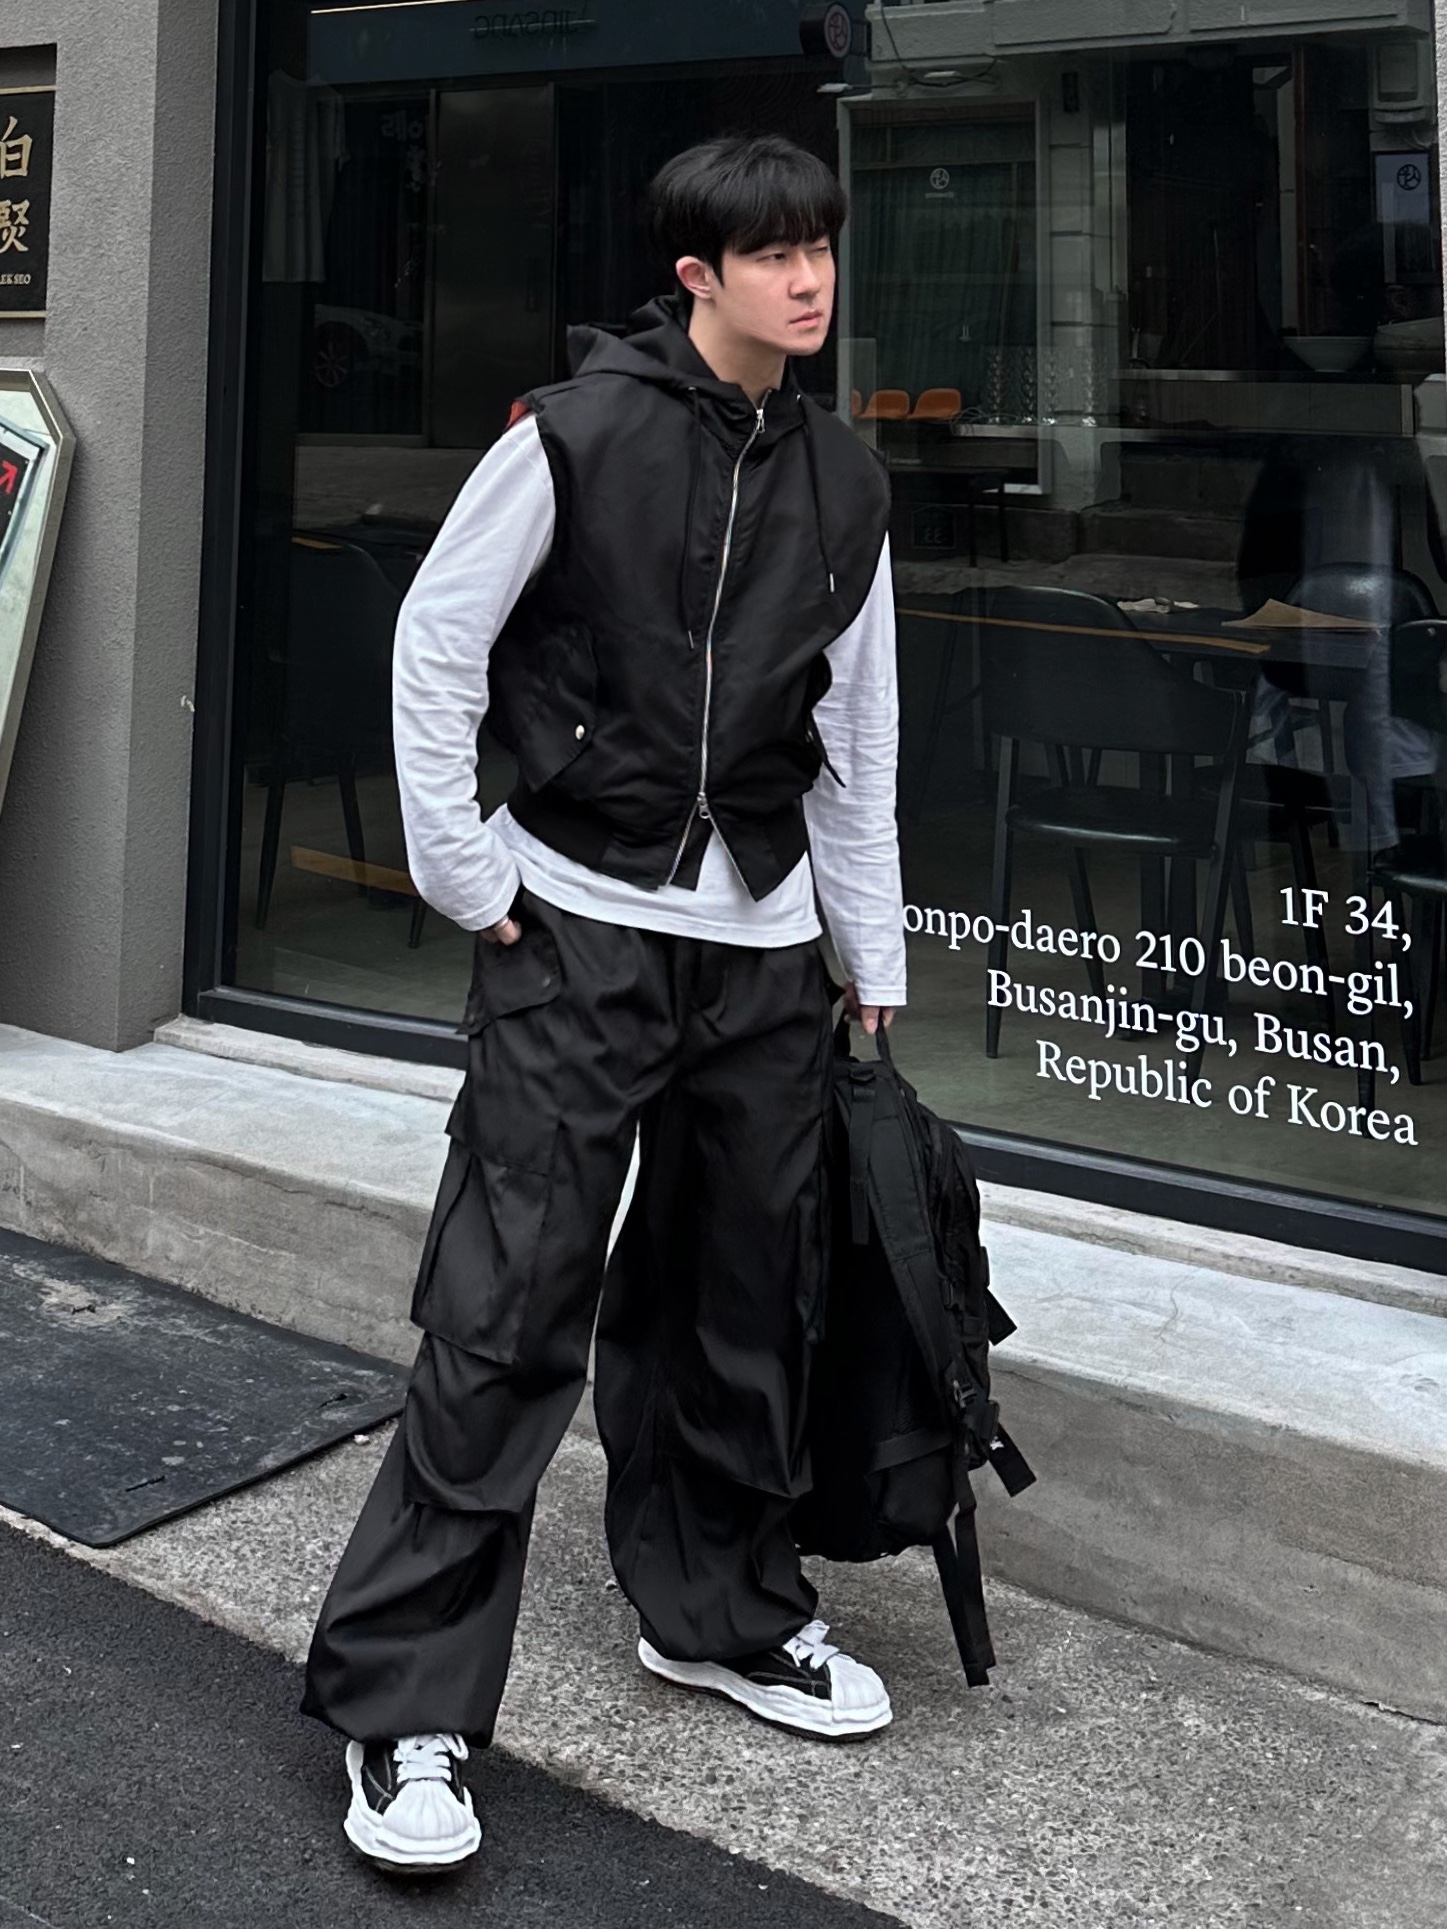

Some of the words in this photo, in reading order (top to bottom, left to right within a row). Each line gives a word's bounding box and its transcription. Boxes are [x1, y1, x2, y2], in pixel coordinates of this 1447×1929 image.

[13, 273, 31, 285] SEO
[903, 904, 1121, 963] onpo-daero
[1135, 930, 1206, 976] 210
[1220, 938, 1413, 1020] beon-gil,
[1280, 886, 1329, 929] 1F
[1344, 895, 1413, 952] 34,
[987, 968, 1238, 1058] Busanjin-gu,
[1253, 1012, 1400, 1085] Busan,
[1035, 1039, 1212, 1108] Republic
[1228, 1075, 1276, 1119] of
[1286, 1083, 1419, 1146] Korea
